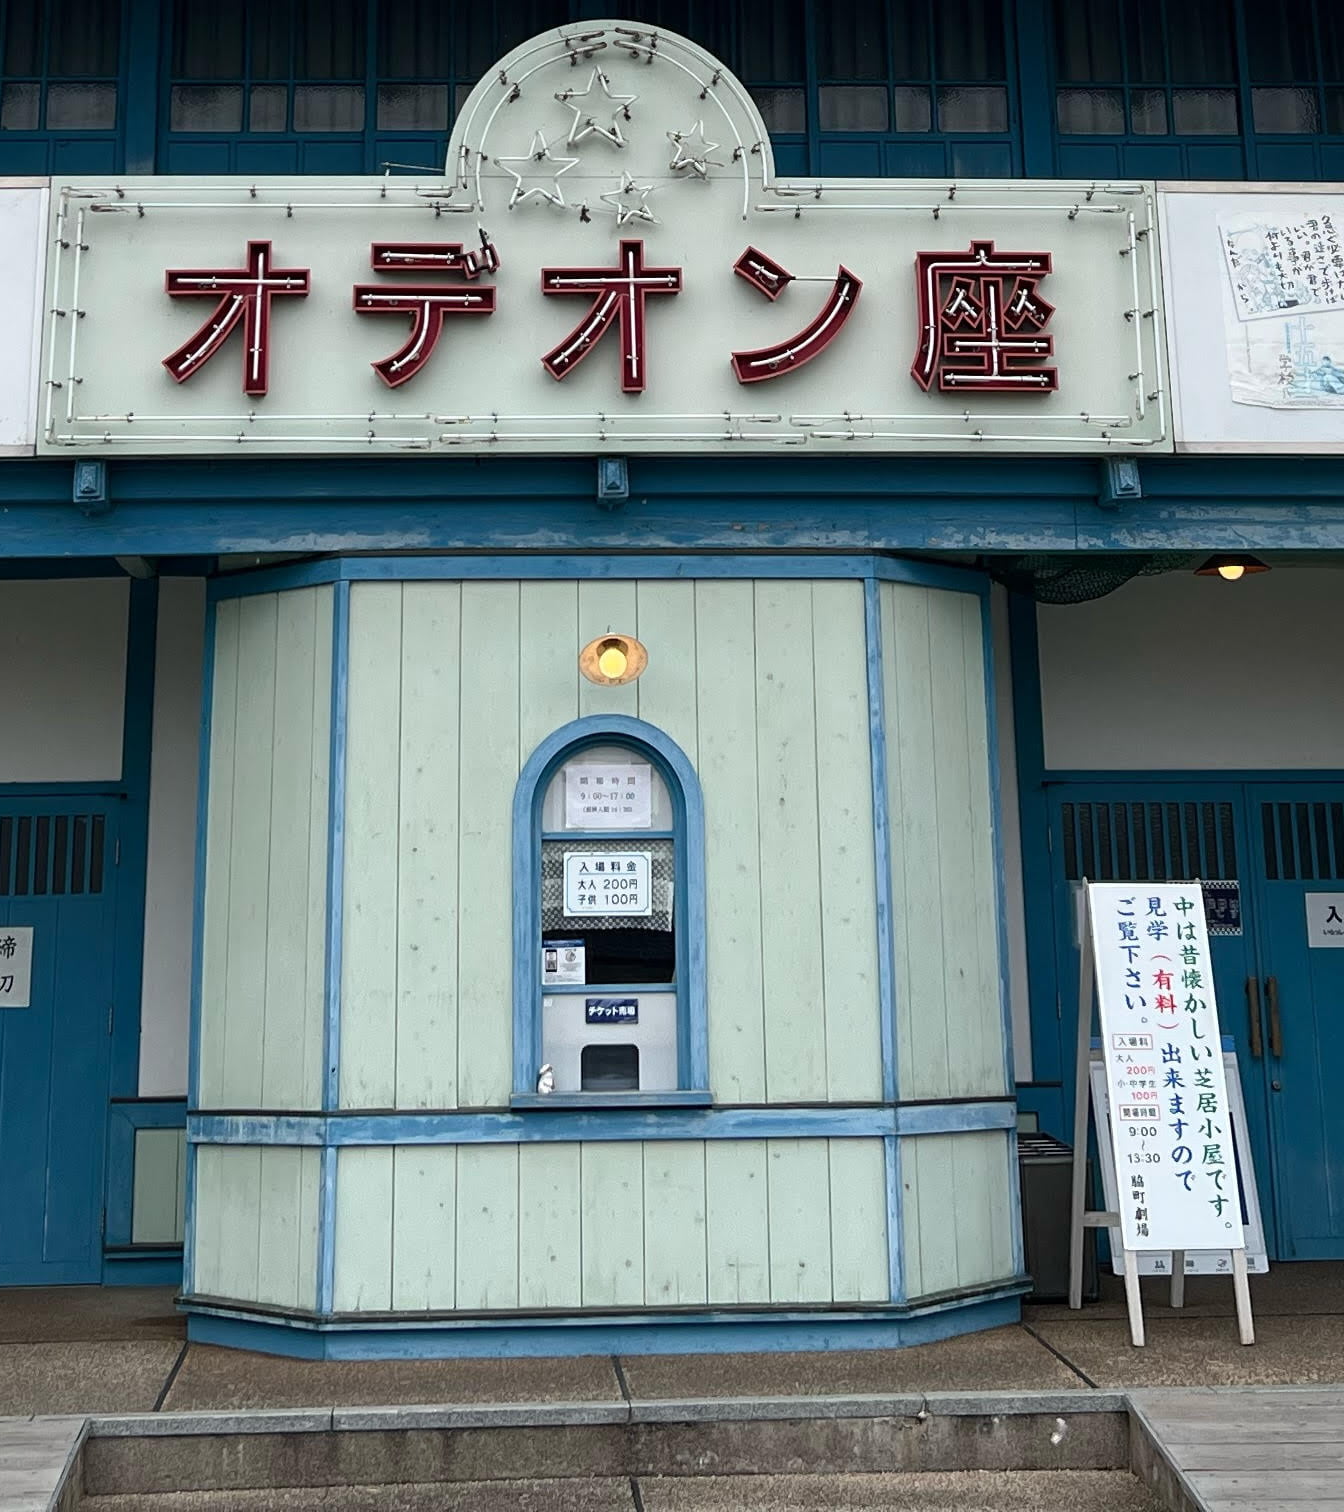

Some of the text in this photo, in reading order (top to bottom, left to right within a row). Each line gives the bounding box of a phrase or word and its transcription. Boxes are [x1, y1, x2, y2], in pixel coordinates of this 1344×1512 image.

[161, 232, 1059, 396] オデオン座
[579, 860, 637, 873] 入場料金
[577, 878, 638, 890] 大人 200円
[577, 893, 638, 905] 子供 100円
[1117, 897, 1148, 1024] ご覧下さい。
[1118, 1037, 1149, 1047] 入場料
[1115, 1054, 1134, 1064] 大人
[1173, 896, 1232, 1229] 中は昔懐かしい芝居小屋です。
[1126, 1066, 1156, 1075] 200円
[1131, 1091, 1158, 1100] 100円
[1128, 1126, 1157, 1137] 9:00
[1130, 1174, 1149, 1237] 脇町劇場
